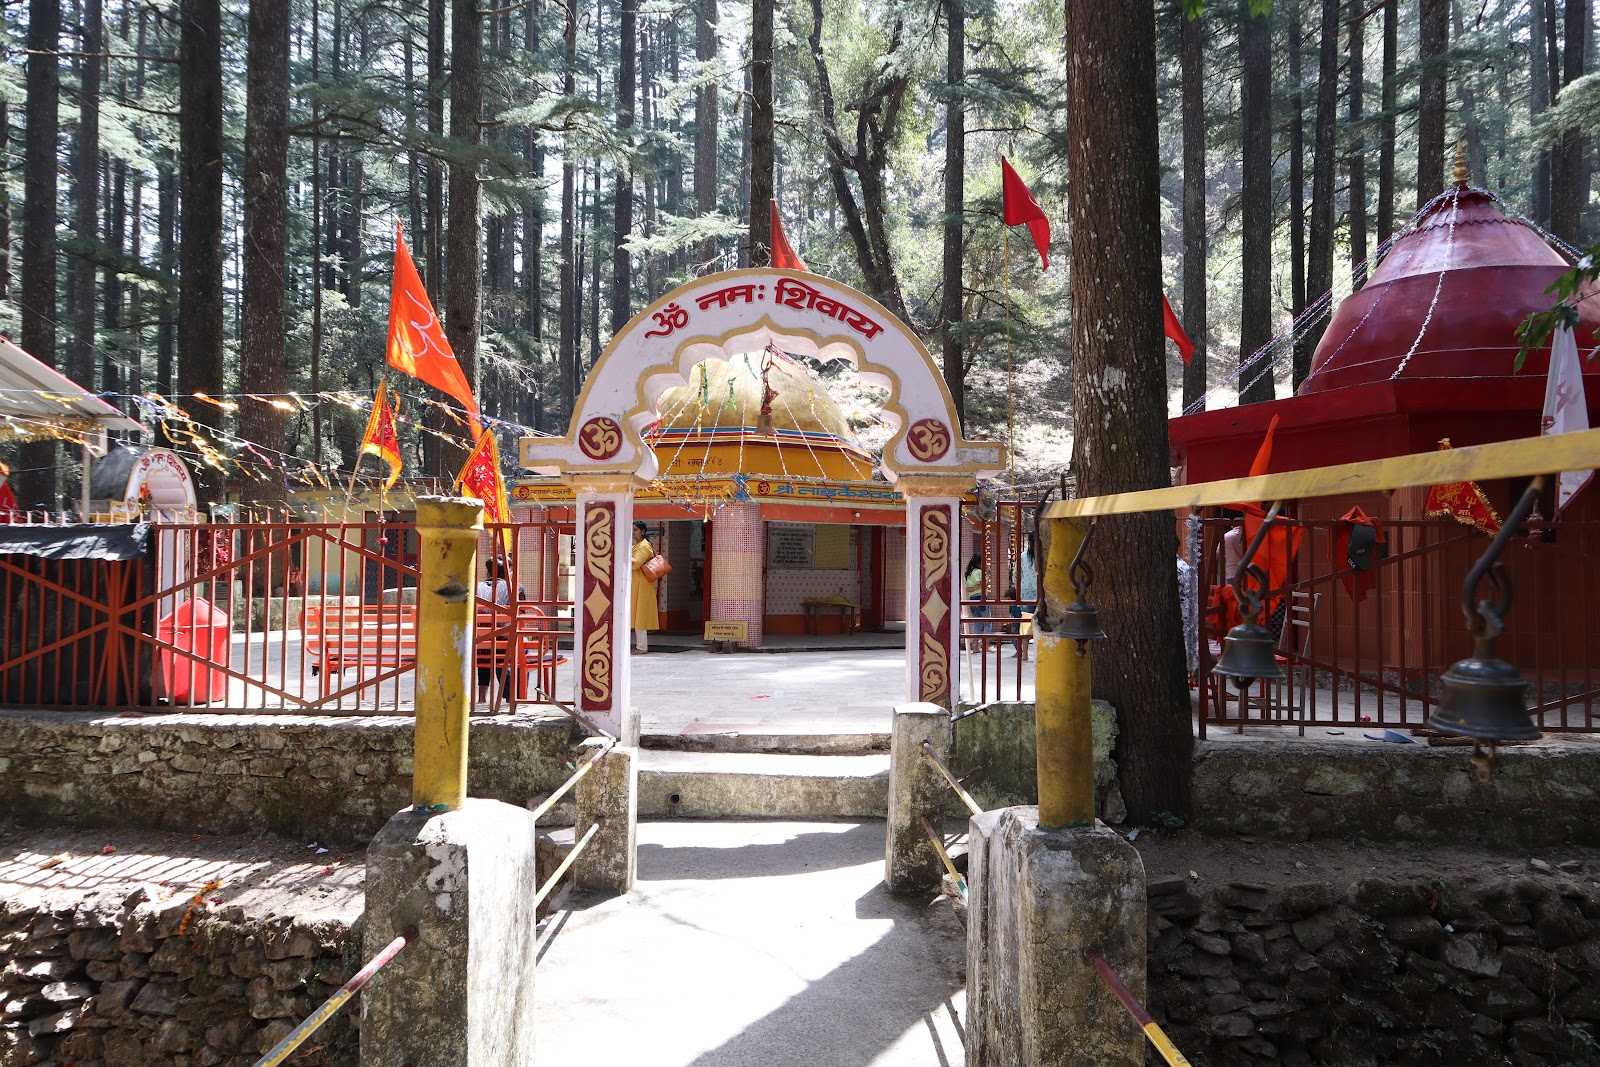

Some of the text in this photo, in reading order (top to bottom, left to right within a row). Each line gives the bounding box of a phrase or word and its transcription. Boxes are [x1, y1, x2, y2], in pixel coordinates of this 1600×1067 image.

[644, 277, 885, 340] ॐ नमः शिवाय
[167, 454, 187, 482] शिवाय
[773, 482, 795, 494] श्री
[1347, 558, 1357, 569] USA
